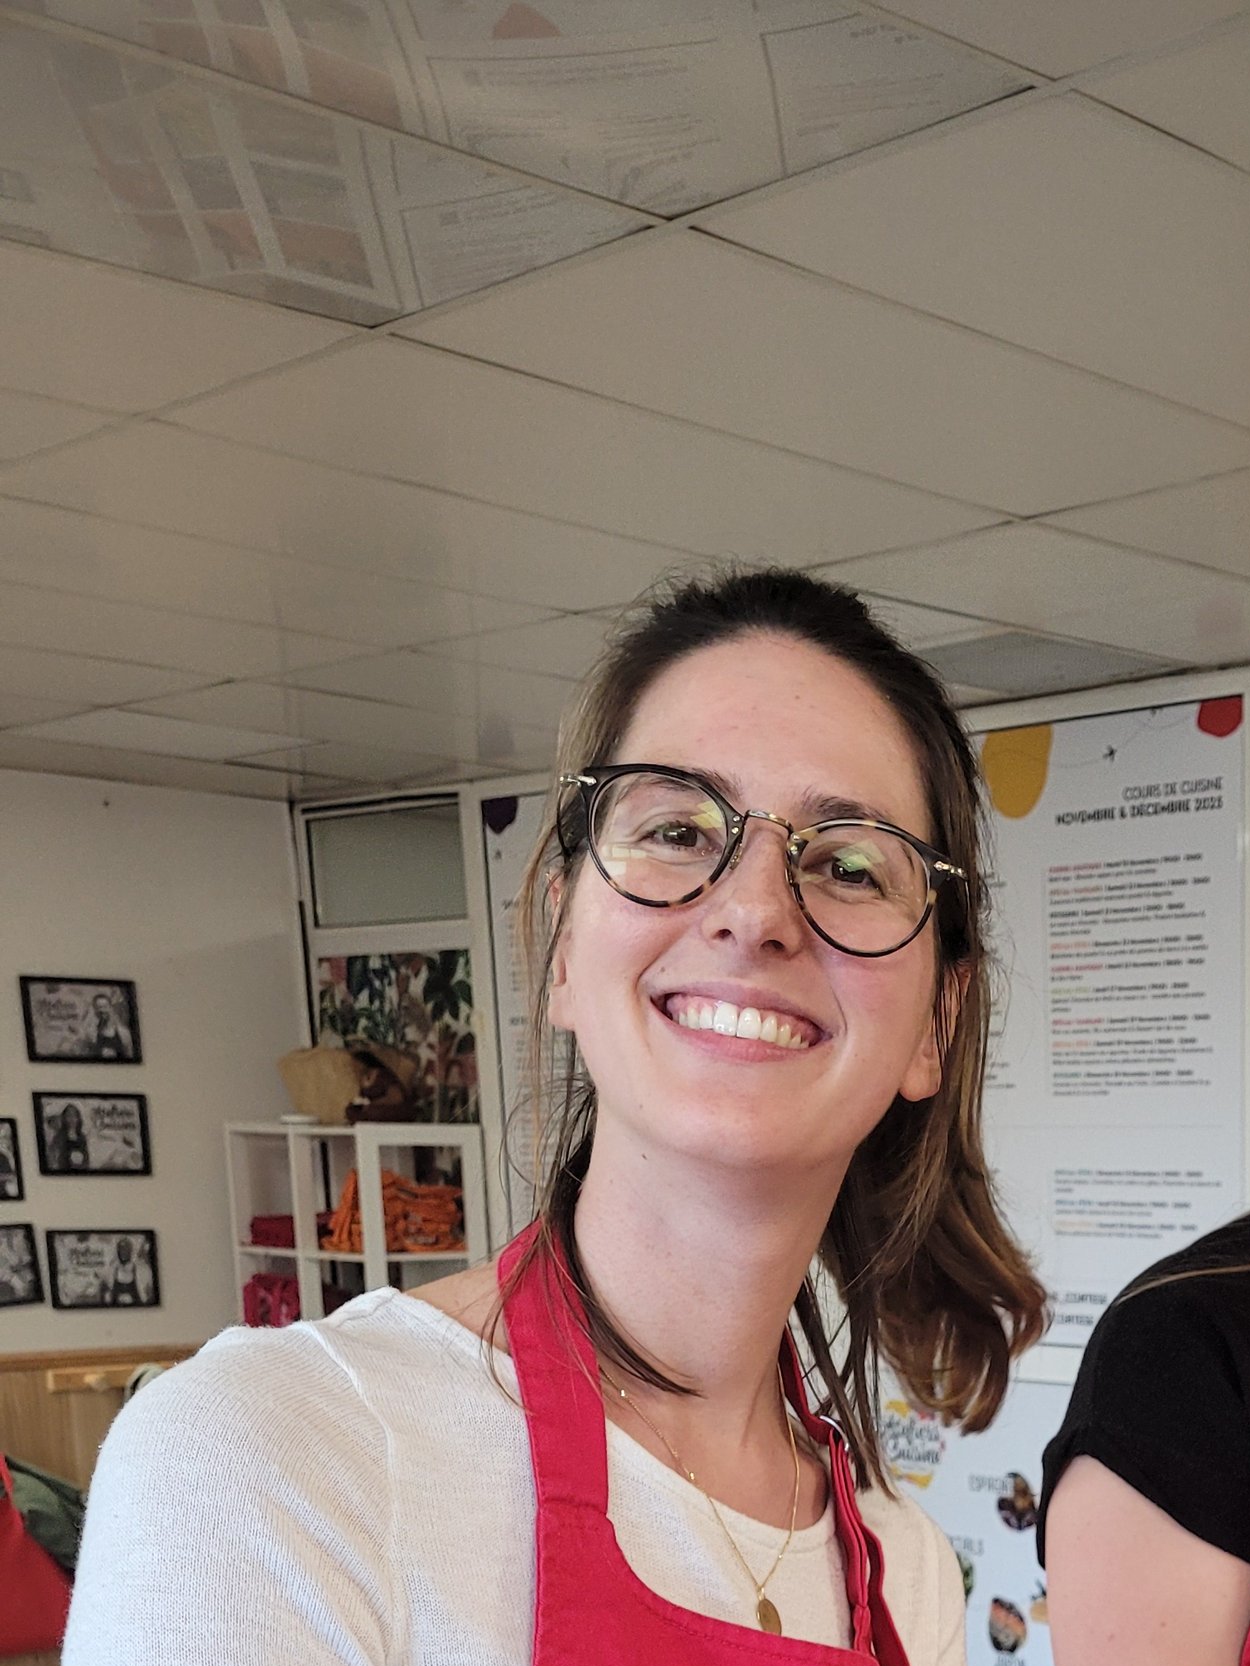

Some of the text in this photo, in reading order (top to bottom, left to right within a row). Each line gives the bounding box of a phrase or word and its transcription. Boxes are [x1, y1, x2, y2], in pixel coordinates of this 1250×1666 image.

[1123, 776, 1223, 801] COURS DE CUISINE
[1055, 807, 1116, 825] NOVEMBRE
